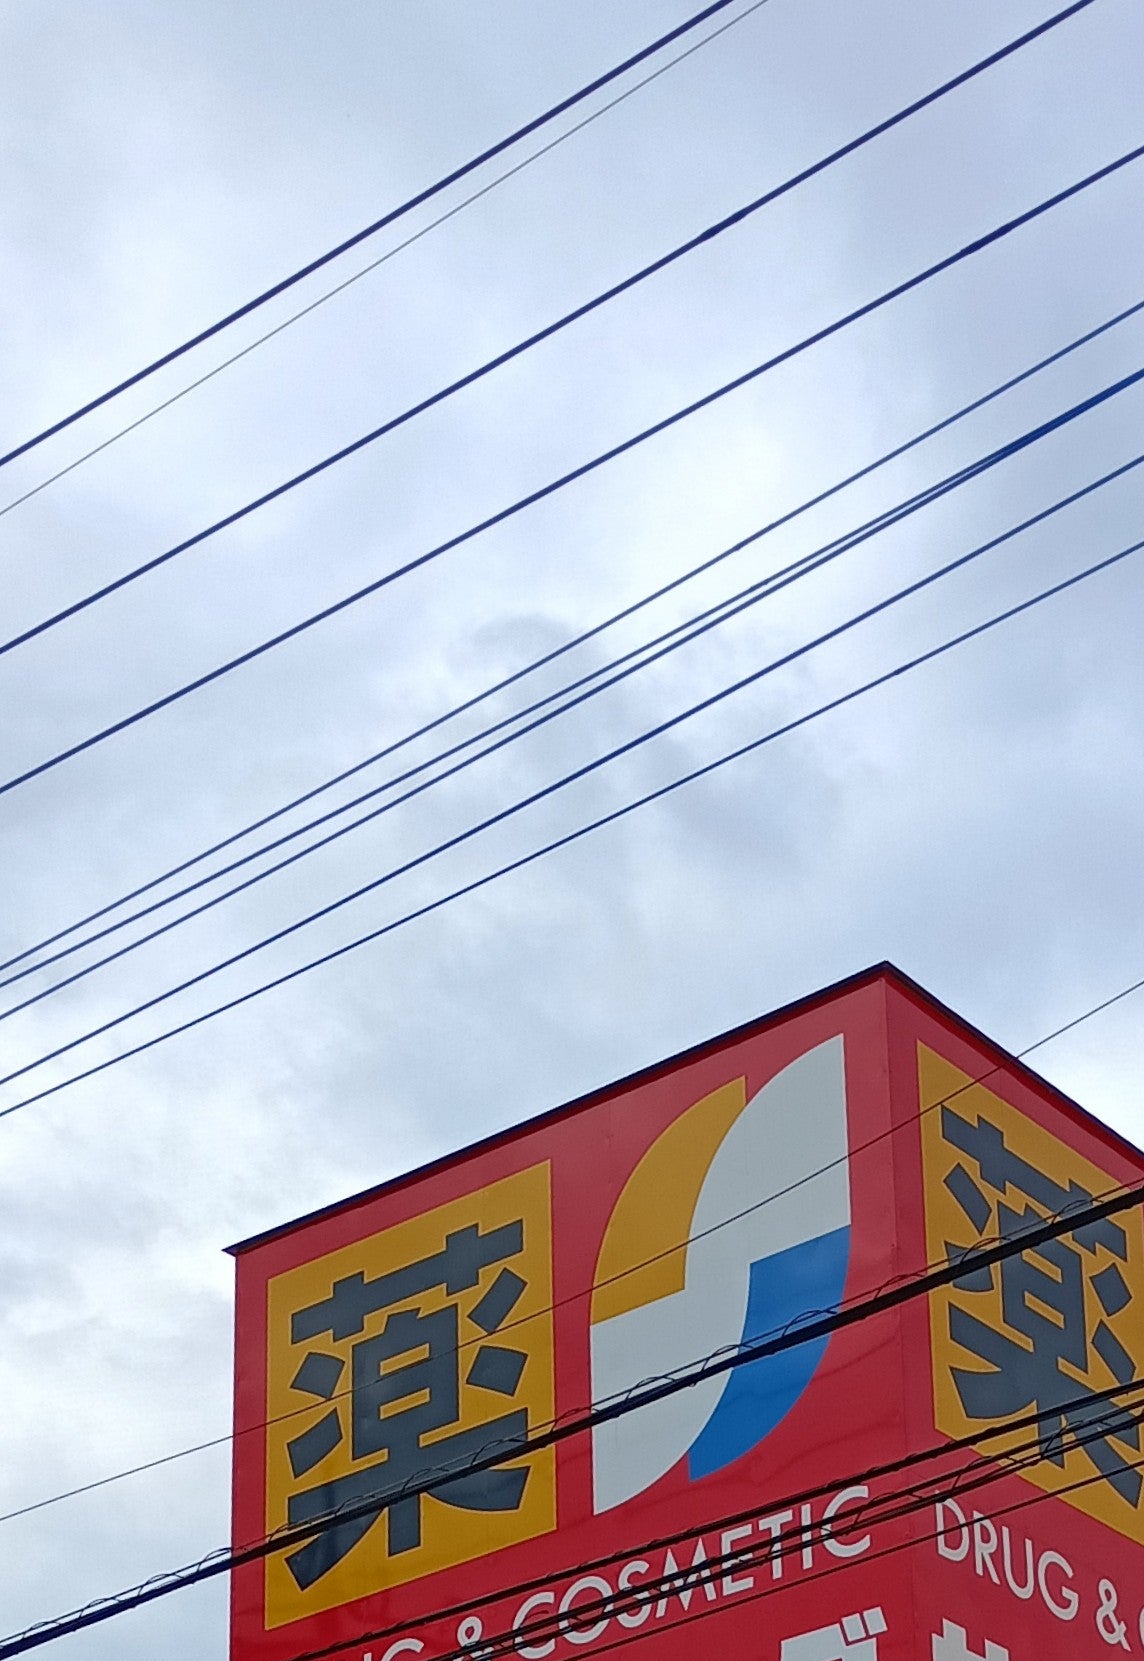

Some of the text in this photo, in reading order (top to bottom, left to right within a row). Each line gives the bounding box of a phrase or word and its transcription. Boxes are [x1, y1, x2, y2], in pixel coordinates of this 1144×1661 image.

[284, 1218, 528, 1592] 薬
[942, 1105, 1144, 1510] 薬
[511, 1486, 872, 1660] COSMETIC
[935, 1491, 1079, 1621] DRUG
[1096, 1578, 1132, 1652] &
